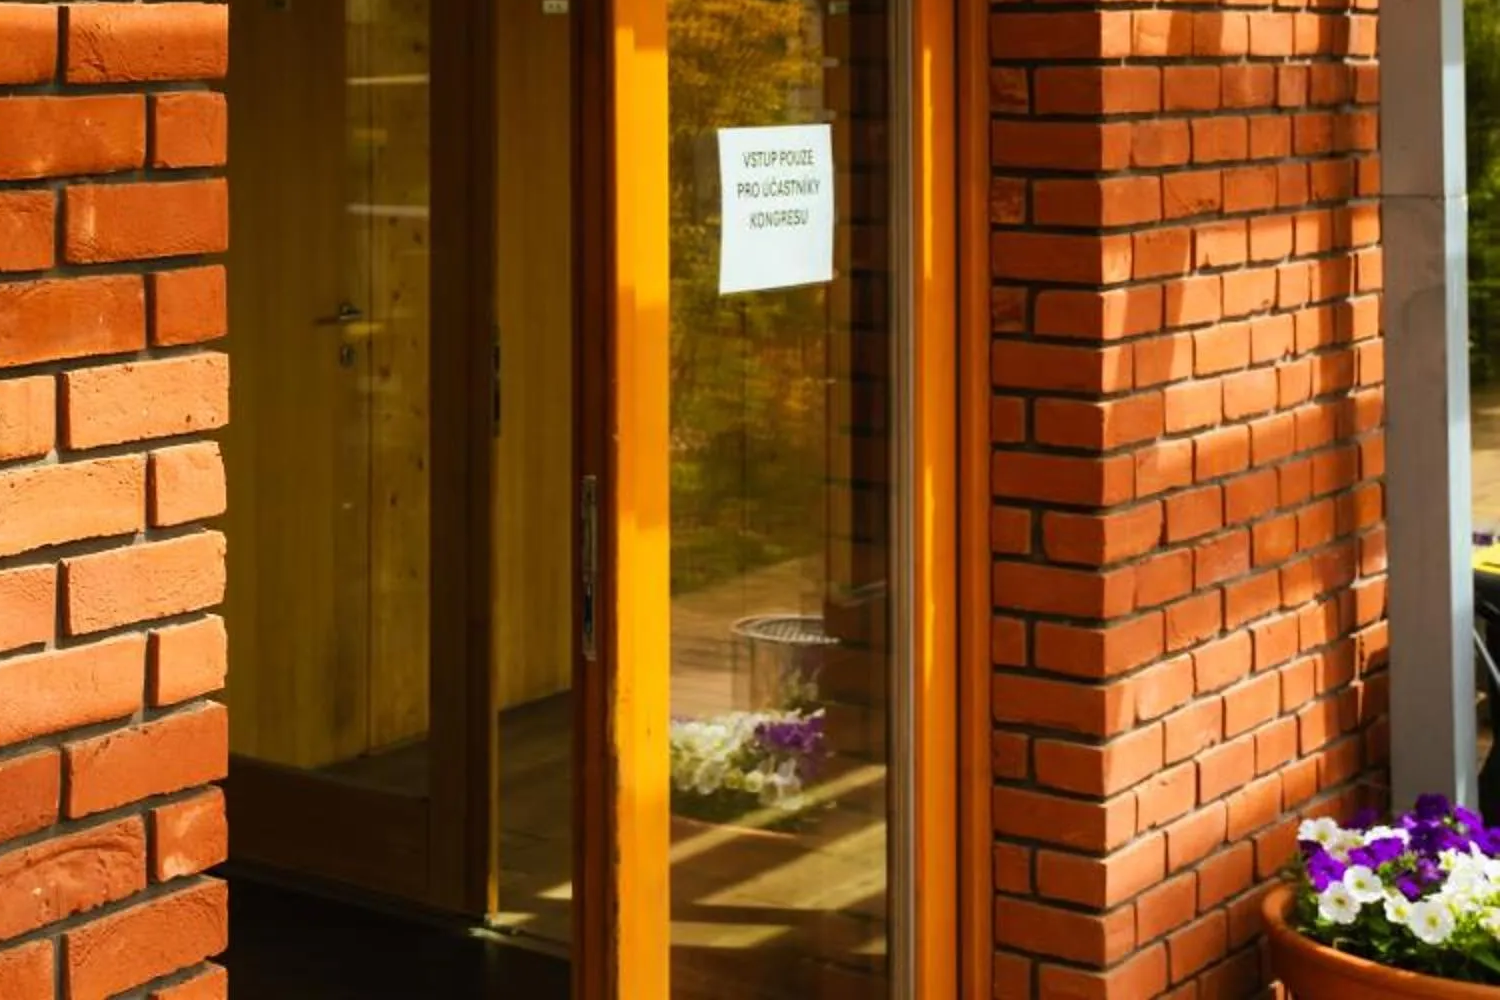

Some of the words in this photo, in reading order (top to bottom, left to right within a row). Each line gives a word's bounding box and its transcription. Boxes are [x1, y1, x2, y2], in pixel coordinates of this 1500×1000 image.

[742, 150, 777, 168] VSTUP
[779, 149, 814, 166] POUZE
[737, 181, 760, 198] PRO
[749, 208, 809, 229] KONGRESU
